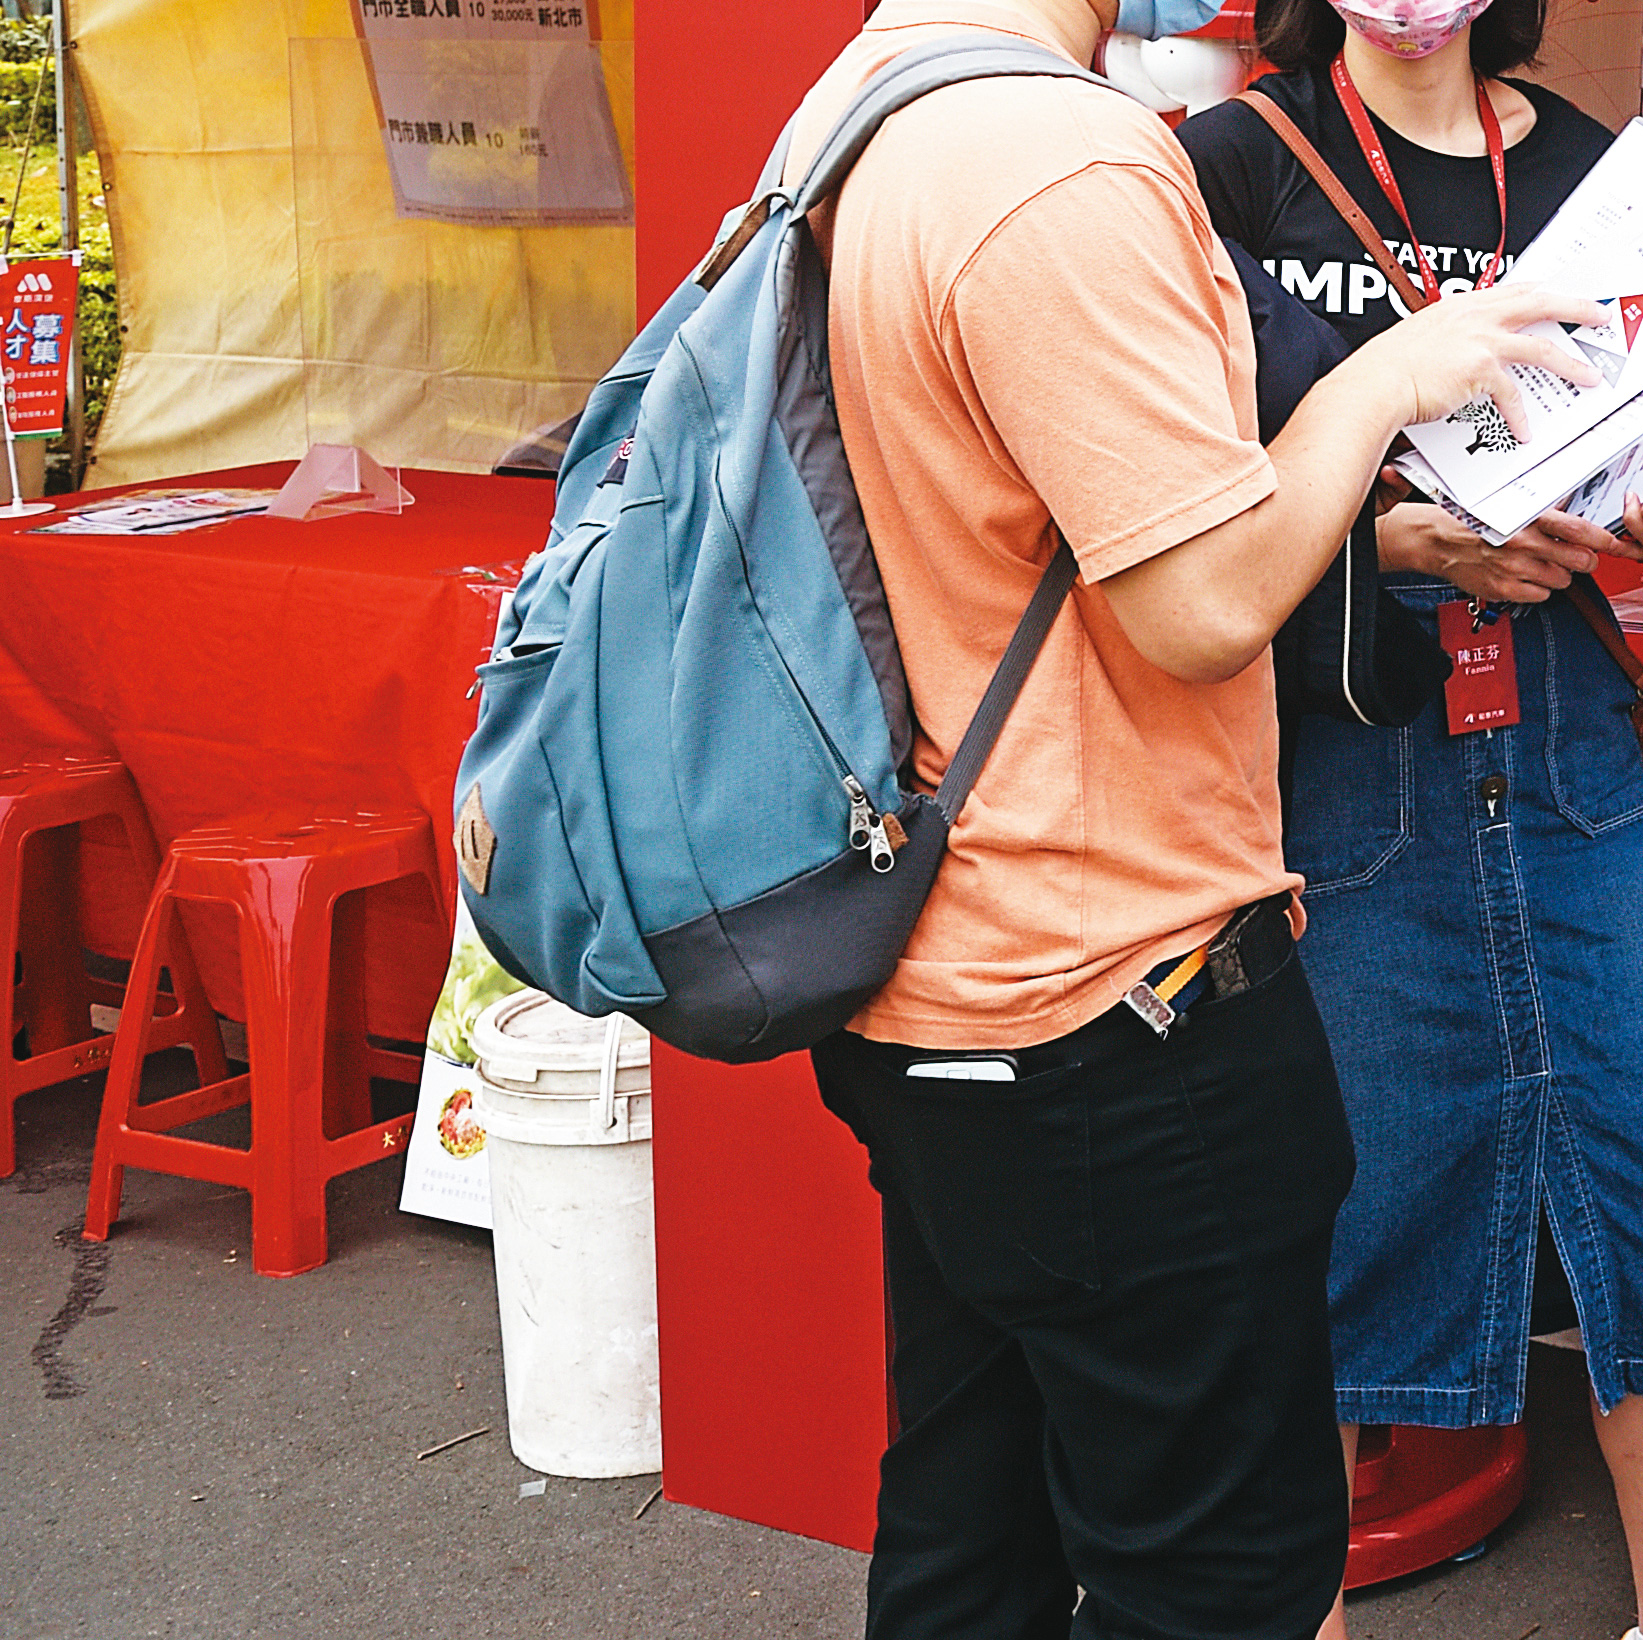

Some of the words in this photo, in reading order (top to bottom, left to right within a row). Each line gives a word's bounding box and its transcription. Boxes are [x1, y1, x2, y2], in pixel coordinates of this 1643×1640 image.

[469, 2, 485, 18] 10
[538, 8, 583, 28] 新北市
[486, 133, 503, 148] 10
